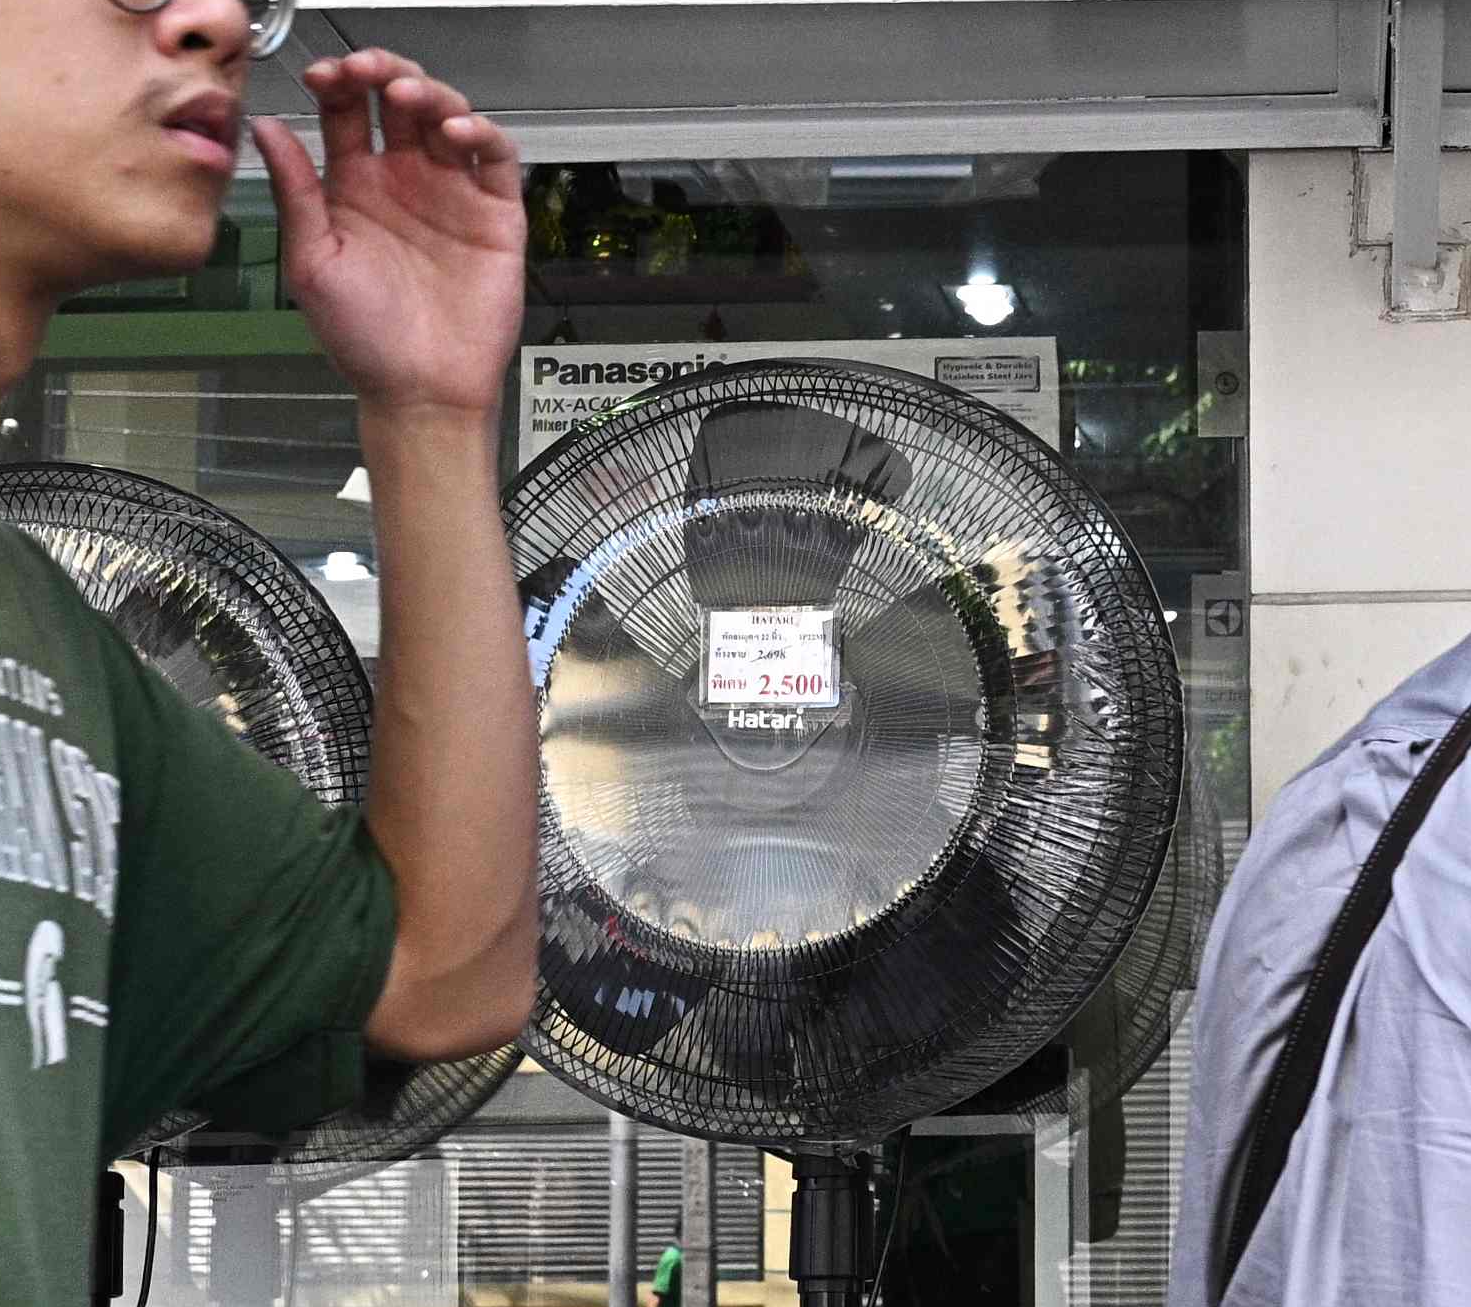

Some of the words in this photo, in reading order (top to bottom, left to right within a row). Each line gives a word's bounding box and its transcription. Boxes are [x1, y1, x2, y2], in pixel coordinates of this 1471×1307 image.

[532, 419, 568, 433] Mixer
[752, 615, 795, 626] HATARI
[711, 674, 747, 690] พิเศษ
[758, 674, 823, 698] 2,500
[728, 707, 804, 730] Hatari
